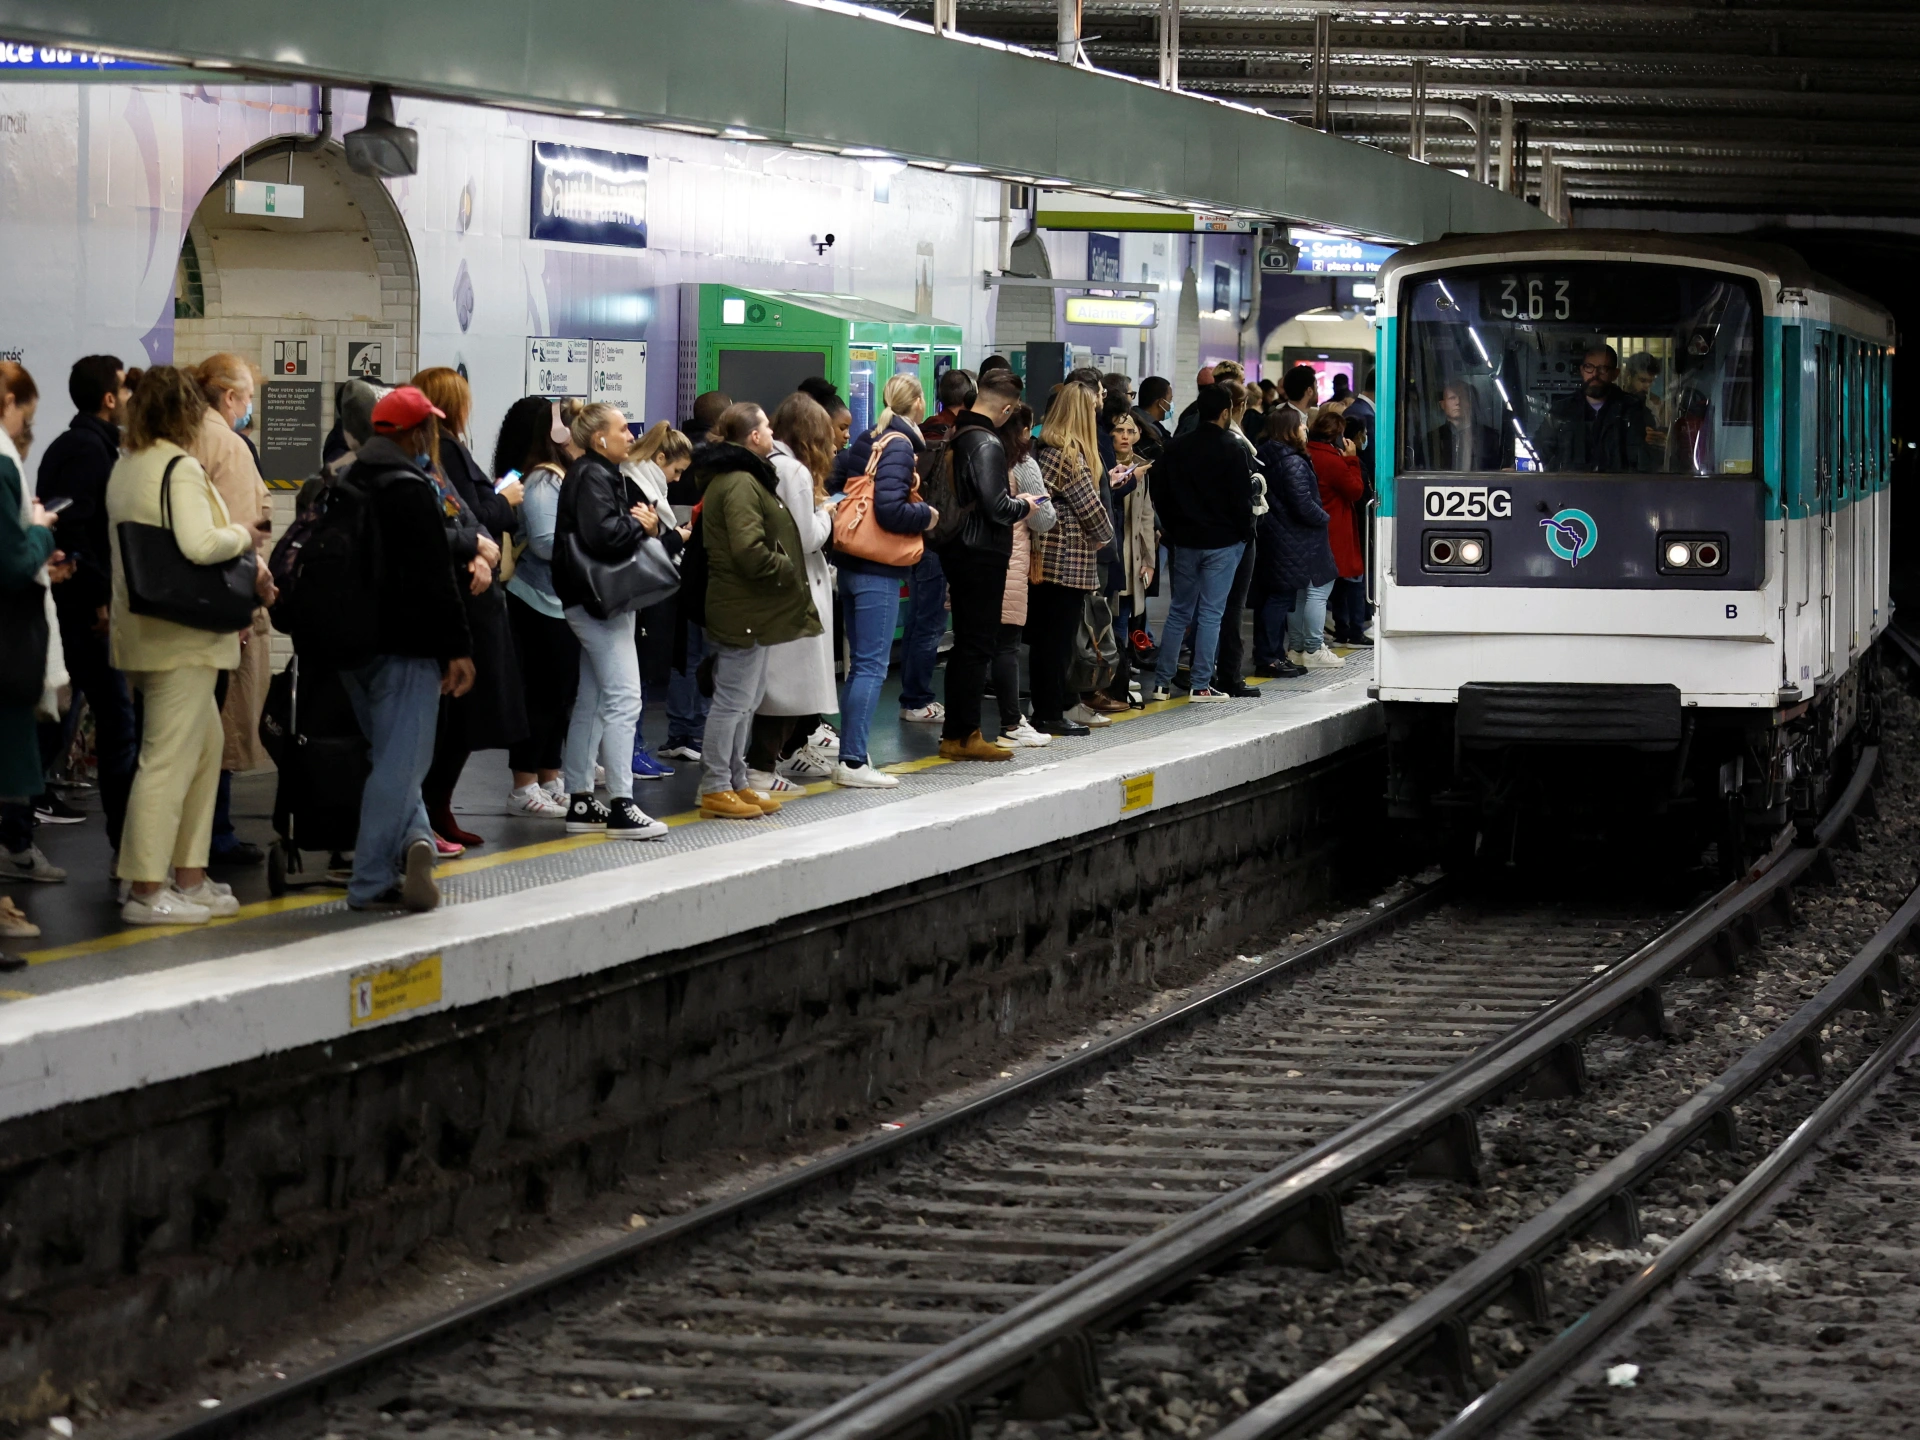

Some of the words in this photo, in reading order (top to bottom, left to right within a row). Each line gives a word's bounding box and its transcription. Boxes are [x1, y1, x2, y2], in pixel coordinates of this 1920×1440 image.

[1312, 242, 1362, 259] Sortie
[1327, 262, 1351, 272] place
[1352, 262, 1364, 271] du
[1077, 306, 1127, 320] Alarme
[1426, 490, 1512, 517] 025G
[1726, 604, 1738, 619] B
